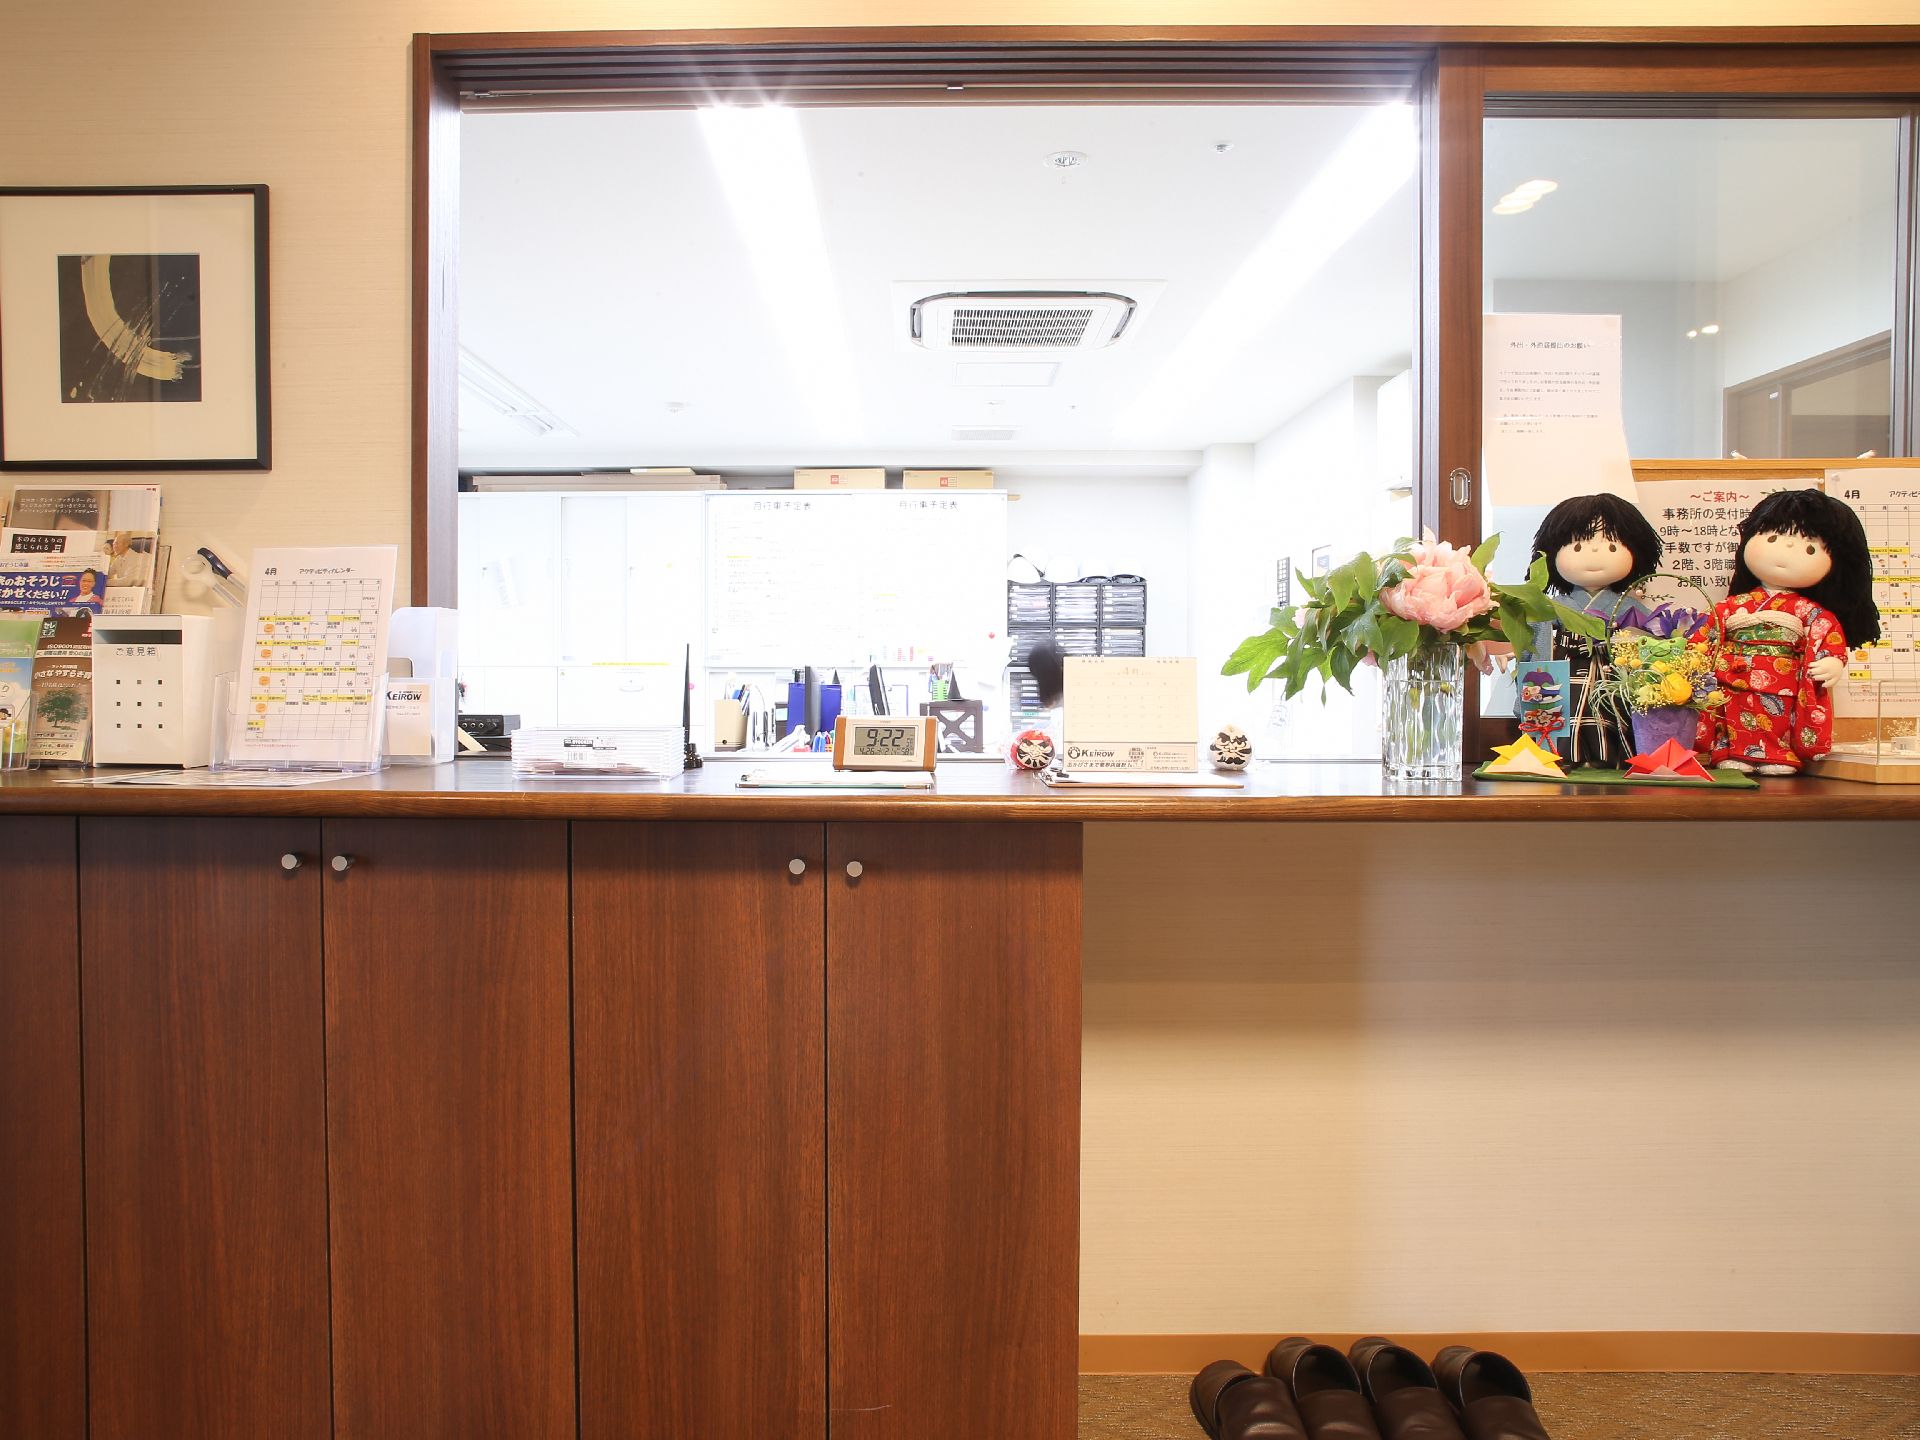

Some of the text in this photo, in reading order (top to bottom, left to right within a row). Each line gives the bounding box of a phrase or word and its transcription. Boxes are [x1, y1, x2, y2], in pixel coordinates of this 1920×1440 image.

[1844, 490, 1860, 499] 4月
[265, 568, 277, 576] 4月
[0, 589, 69, 600] かせください!!
[116, 646, 156, 656] ご意見箱
[866, 728, 905, 747] 9:22
